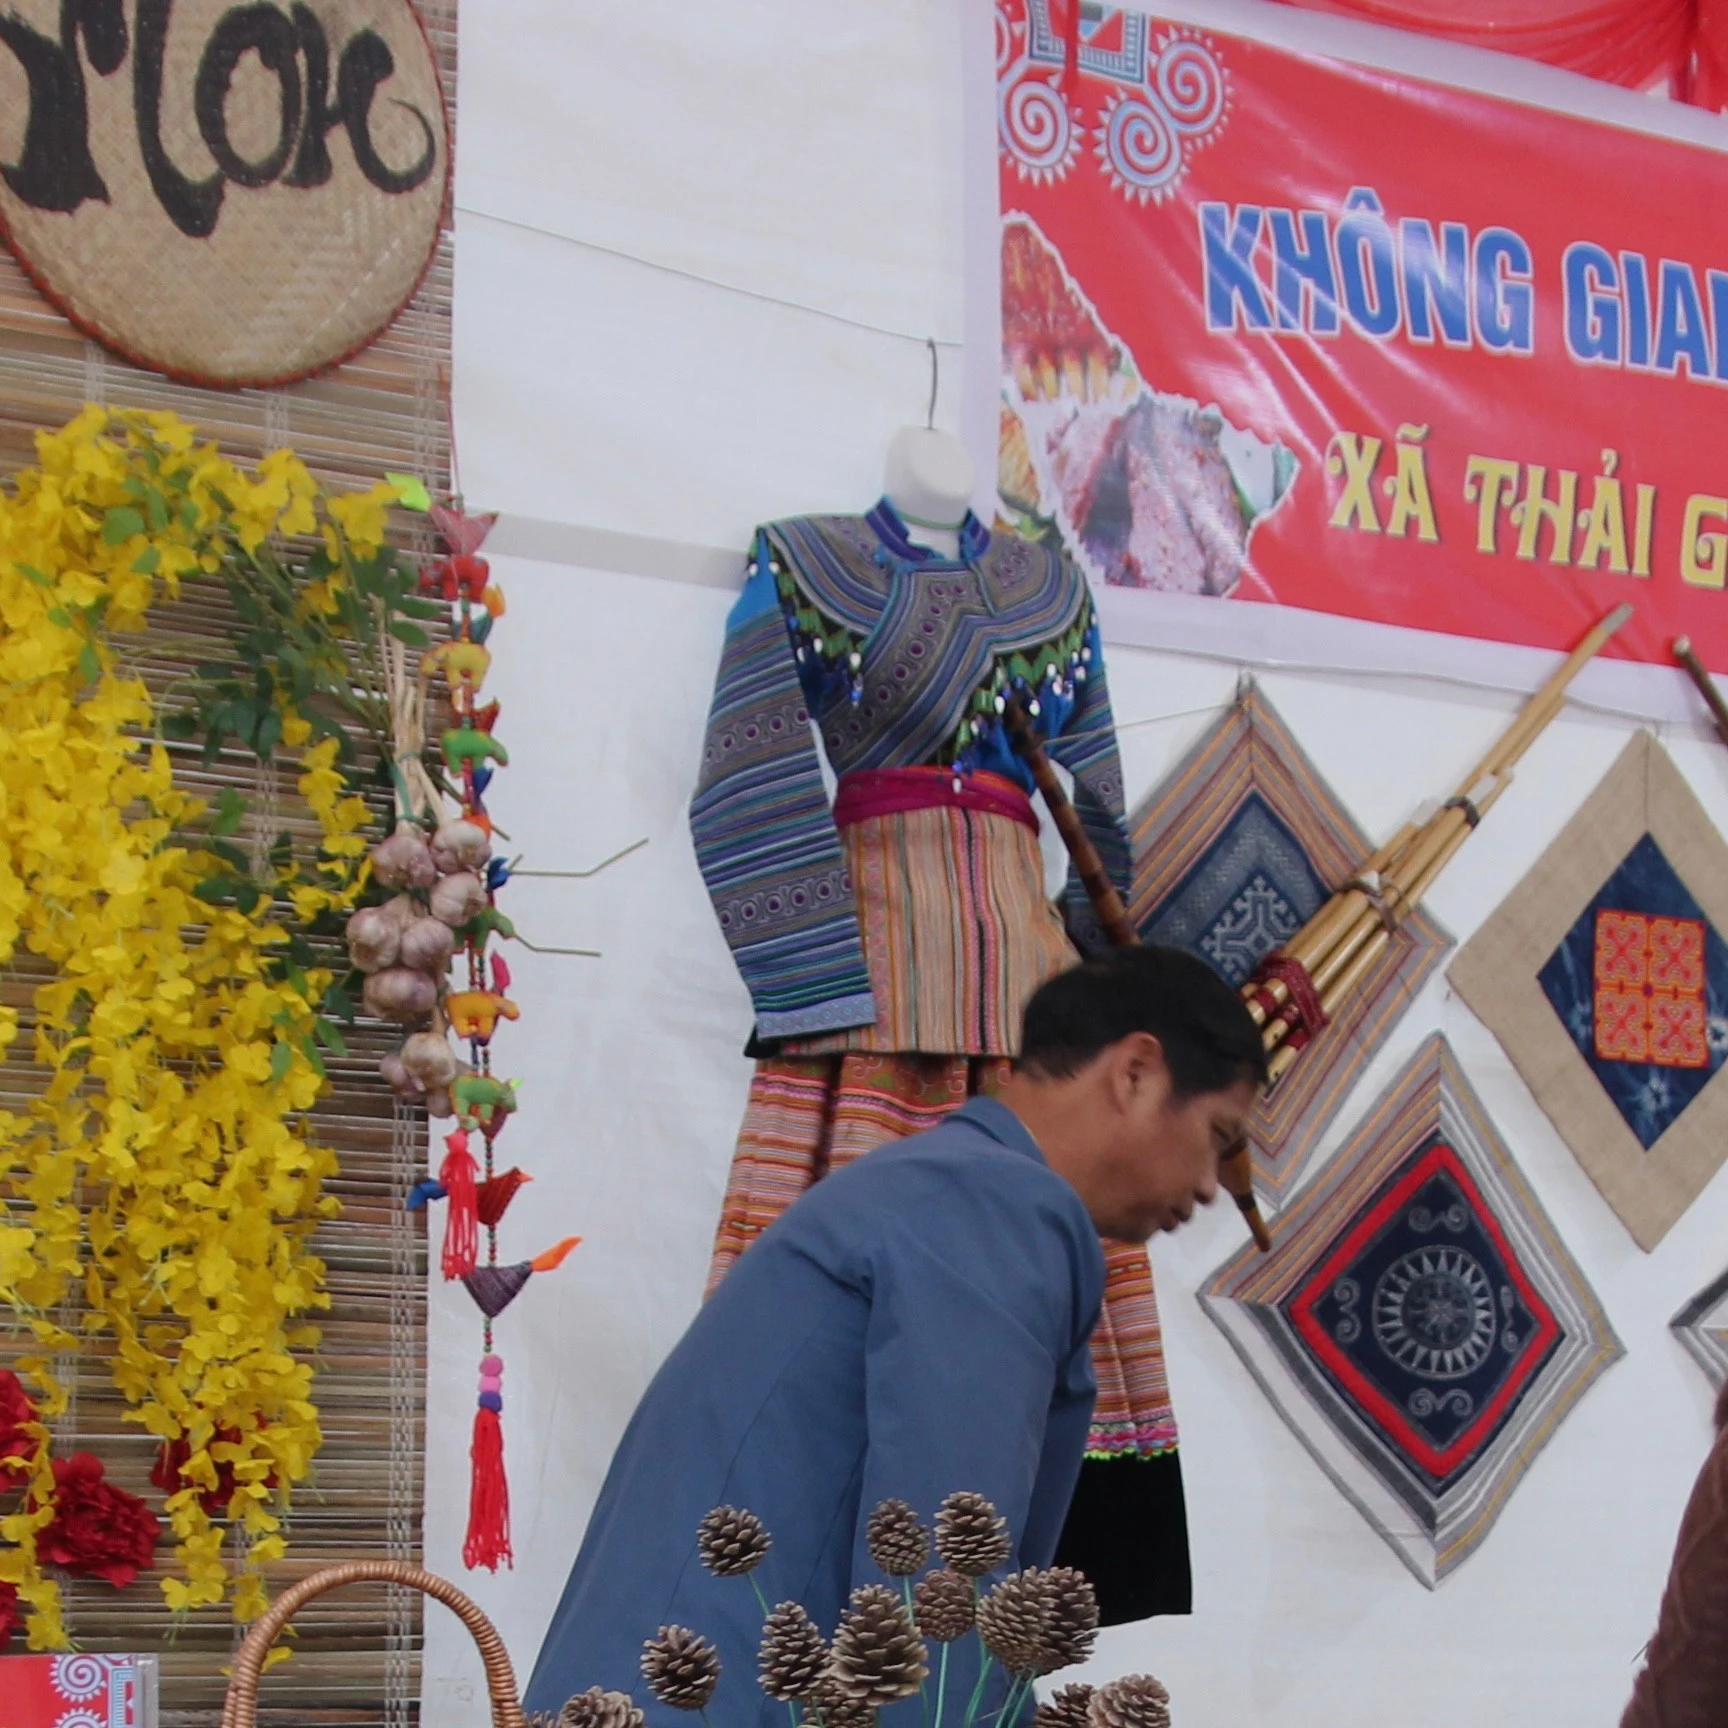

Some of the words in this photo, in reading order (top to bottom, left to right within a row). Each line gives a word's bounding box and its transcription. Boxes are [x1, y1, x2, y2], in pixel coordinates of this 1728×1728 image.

[1197, 187, 1534, 354] KHÔNG
[1327, 422, 1438, 543] XÃ
[1464, 448, 1656, 579] THẢI
